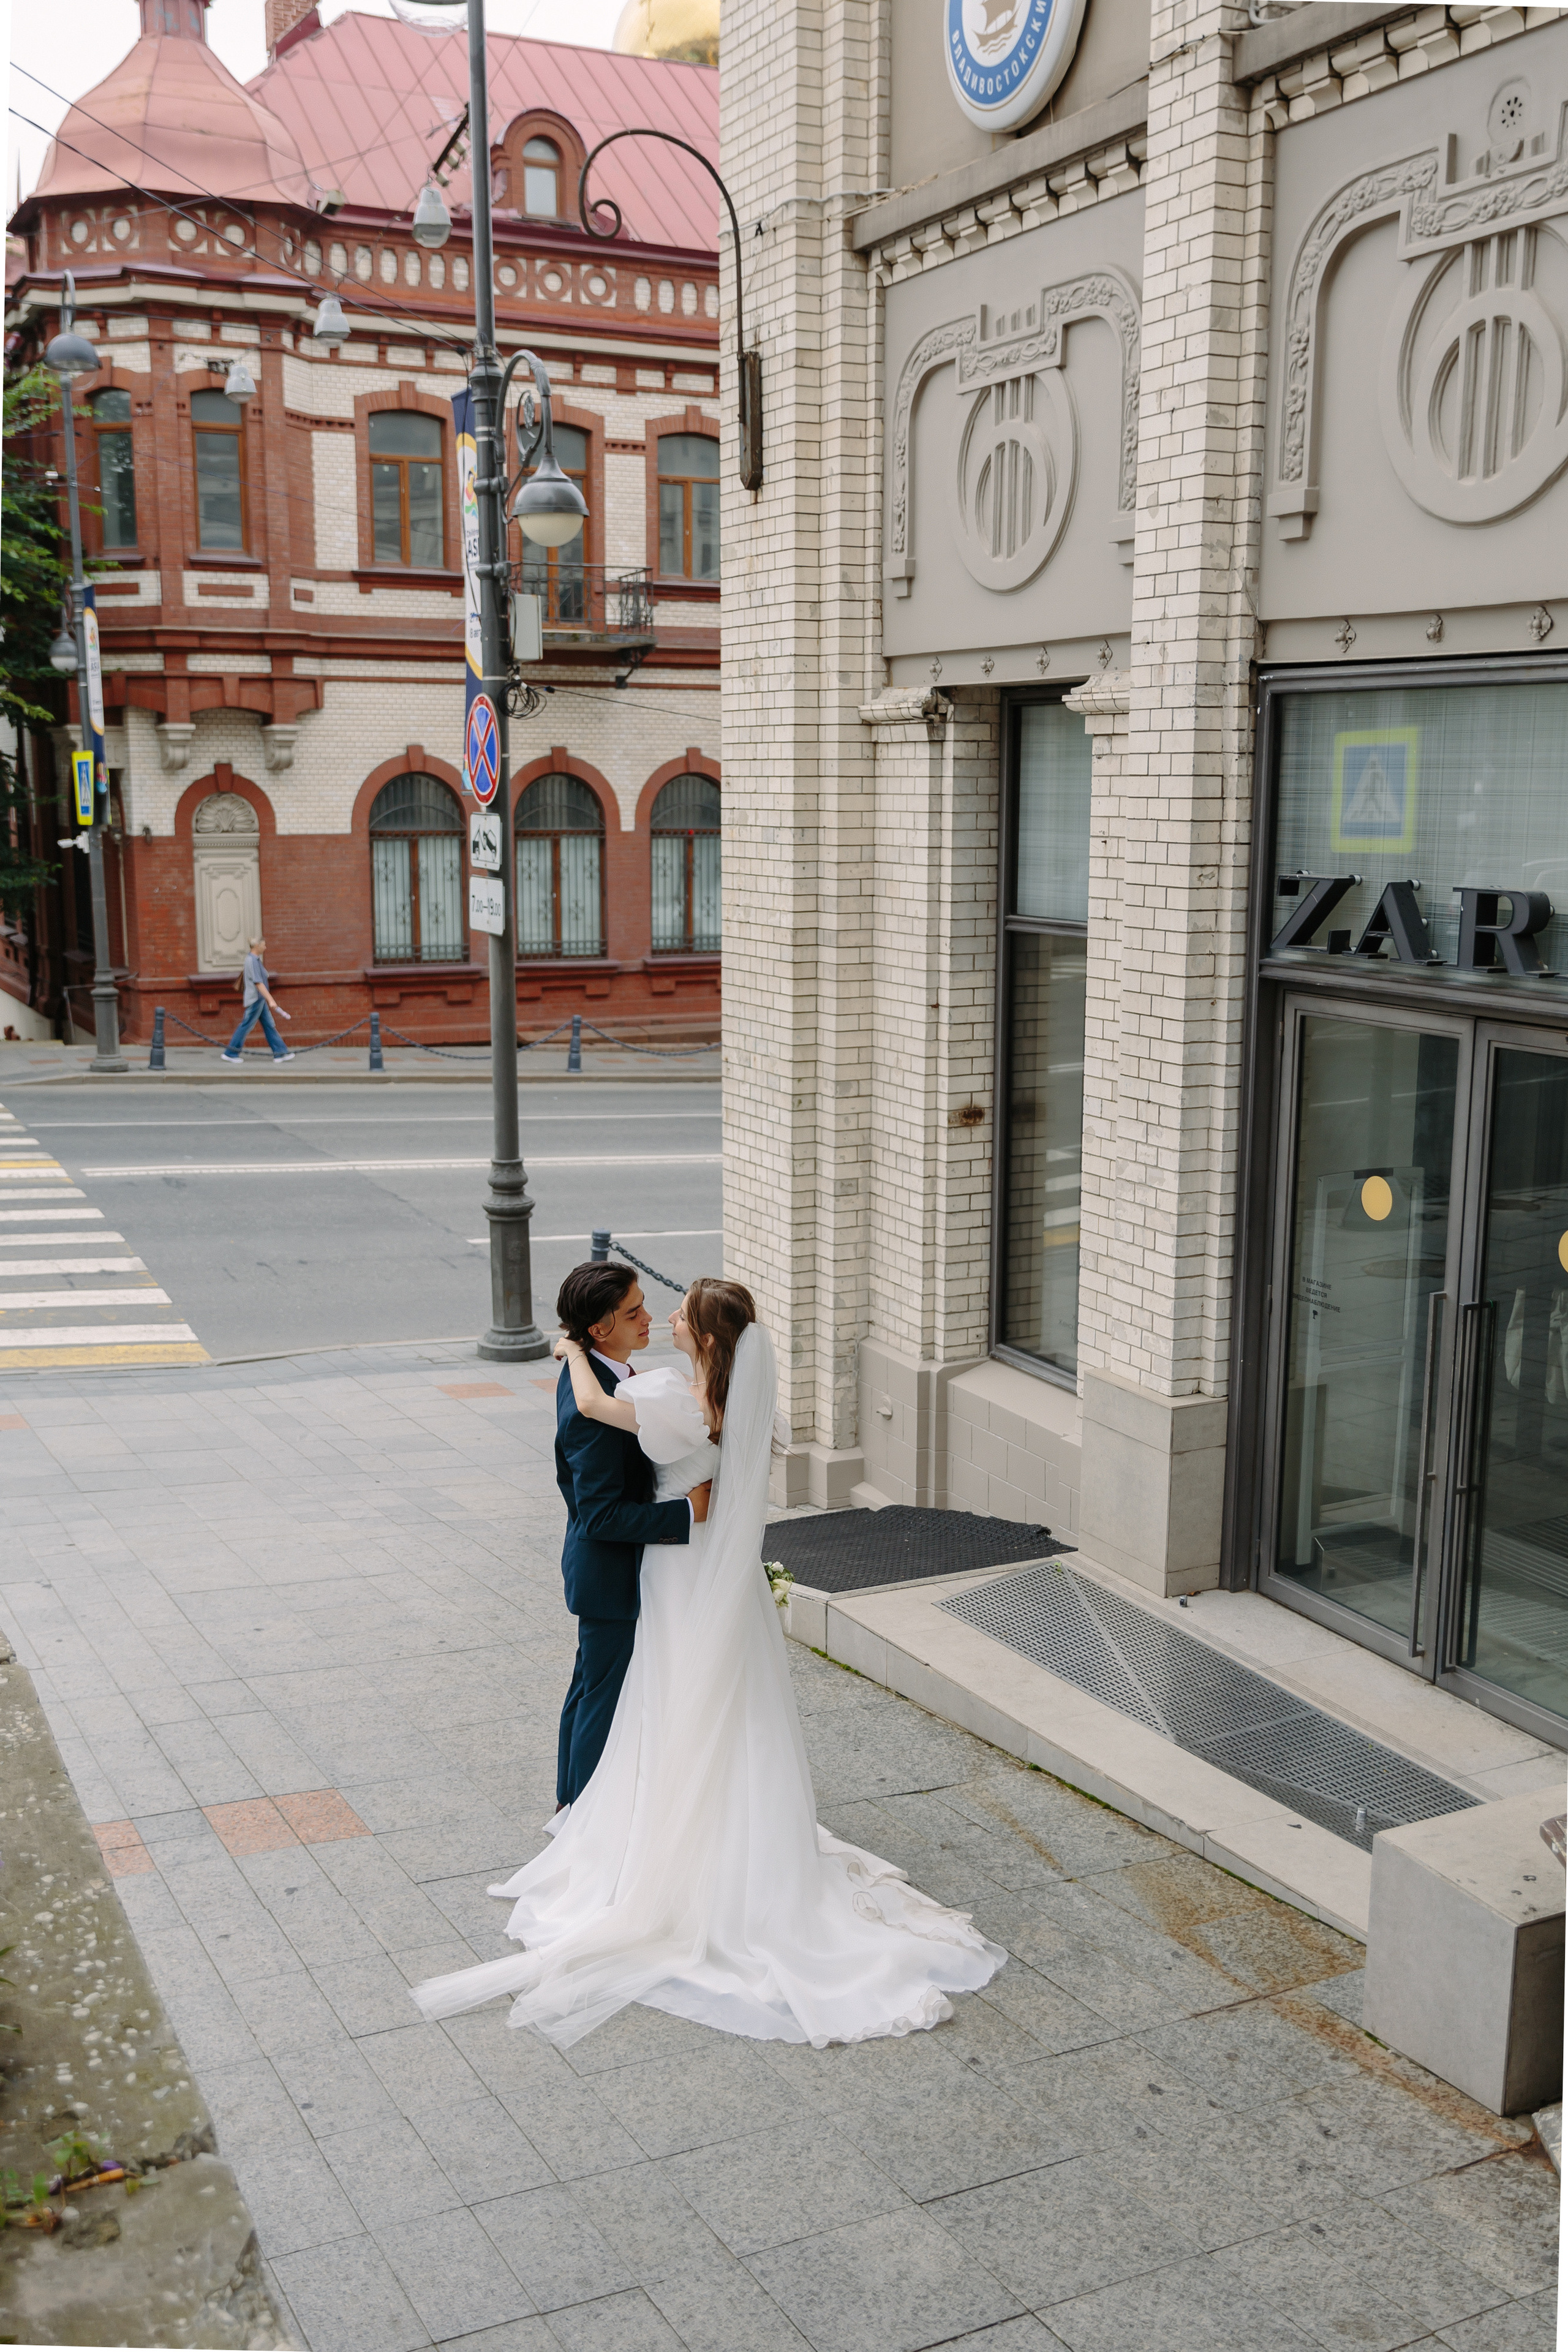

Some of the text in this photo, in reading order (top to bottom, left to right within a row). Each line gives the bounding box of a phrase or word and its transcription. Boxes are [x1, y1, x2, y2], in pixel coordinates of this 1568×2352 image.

[1270, 875, 1567, 979] ZAR
[1306, 1278, 1332, 1291] МАГАЗИНЕ
[1305, 1287, 1327, 1298] ВЕДЕТСЯ
